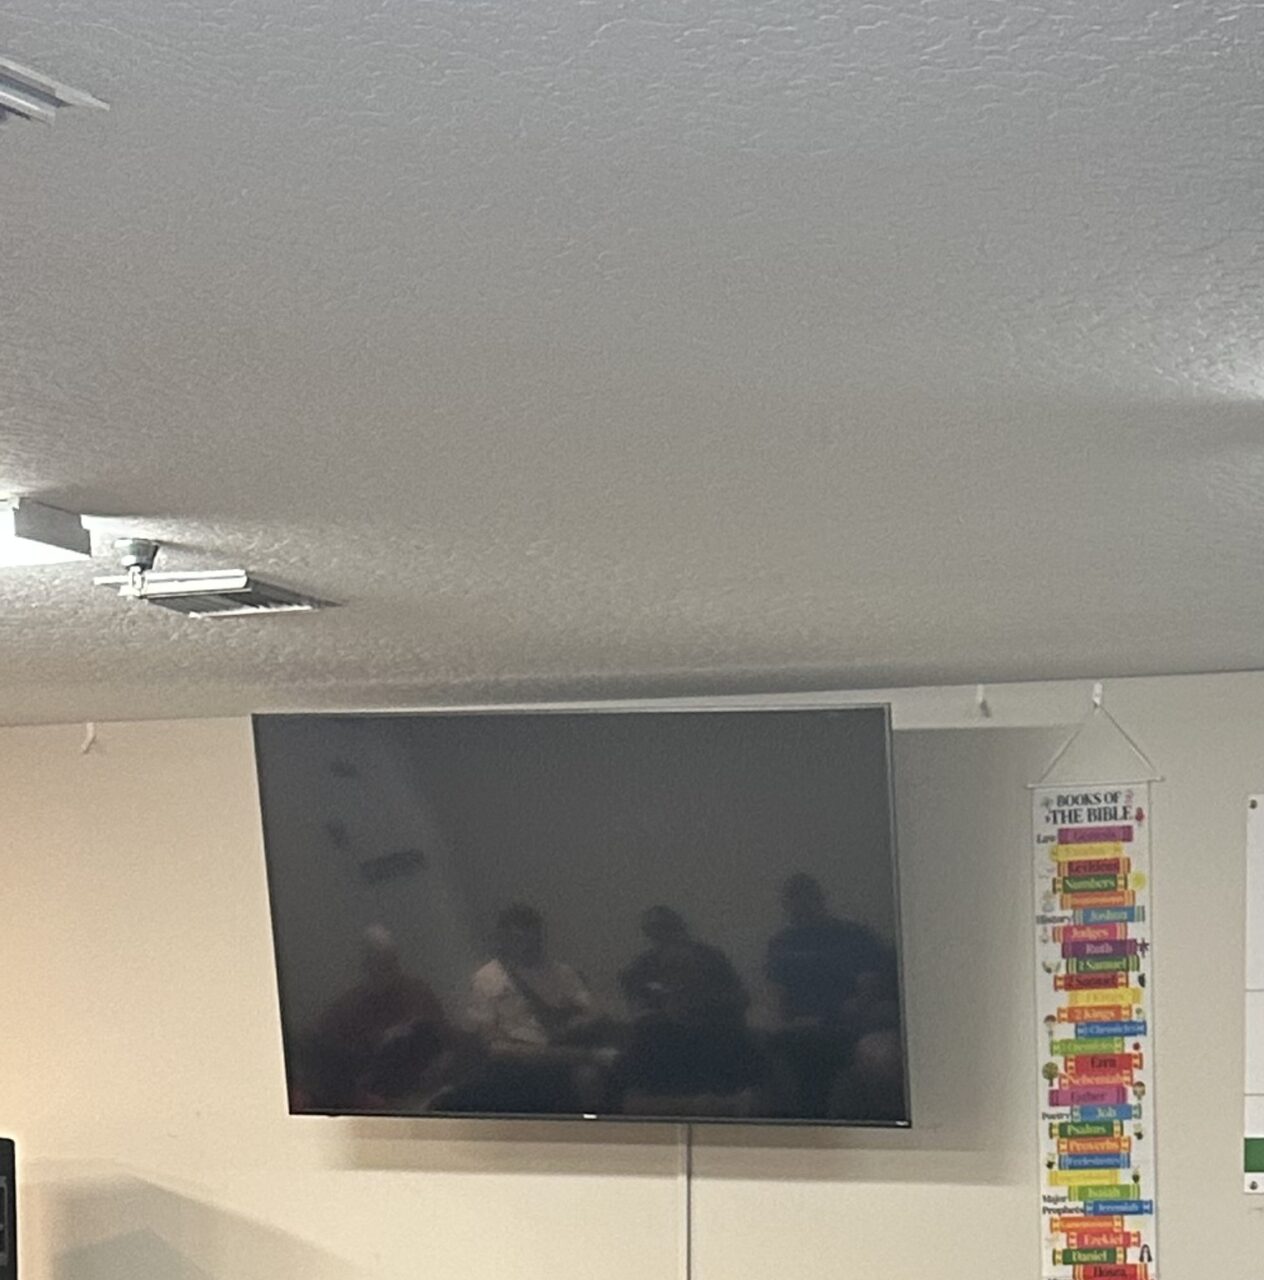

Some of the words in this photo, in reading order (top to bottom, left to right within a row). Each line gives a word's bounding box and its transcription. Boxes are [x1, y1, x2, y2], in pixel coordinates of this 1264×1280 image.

[1056, 793, 1102, 807] BOOKS
[1104, 791, 1122, 804] OF
[1050, 807, 1083, 825] THE
[1086, 805, 1133, 823] BIBLE
